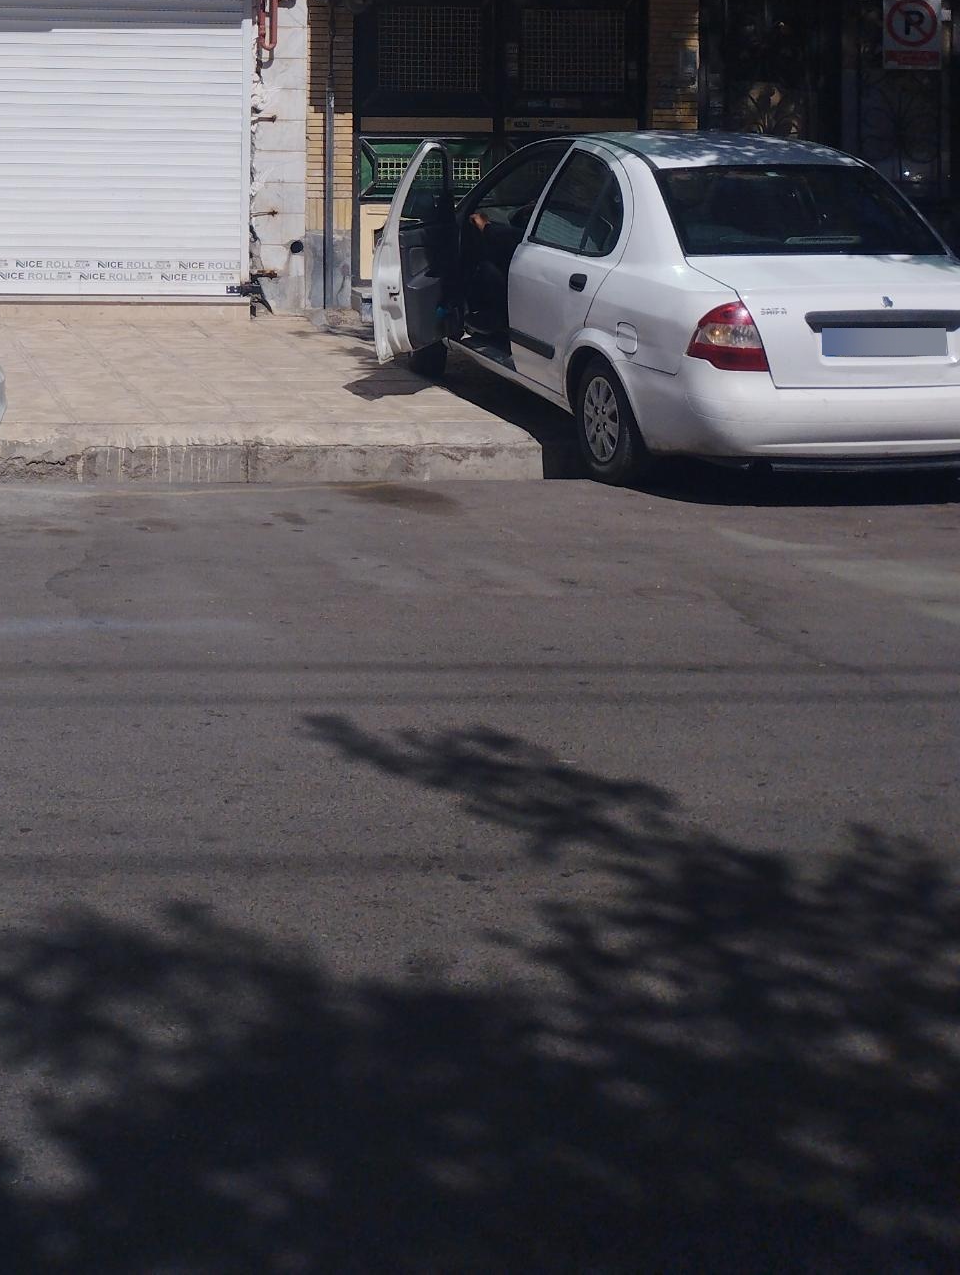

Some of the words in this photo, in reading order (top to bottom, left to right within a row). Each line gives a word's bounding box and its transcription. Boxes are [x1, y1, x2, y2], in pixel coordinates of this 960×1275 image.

[15, 260, 42, 268] NICE
[97, 261, 124, 269] NICE
[179, 261, 205, 269] NICE
[28, 272, 54, 280] ROLL
[80, 272, 105, 280] NICE
[109, 273, 135, 281] ROLL
[161, 273, 187, 281] NICE
